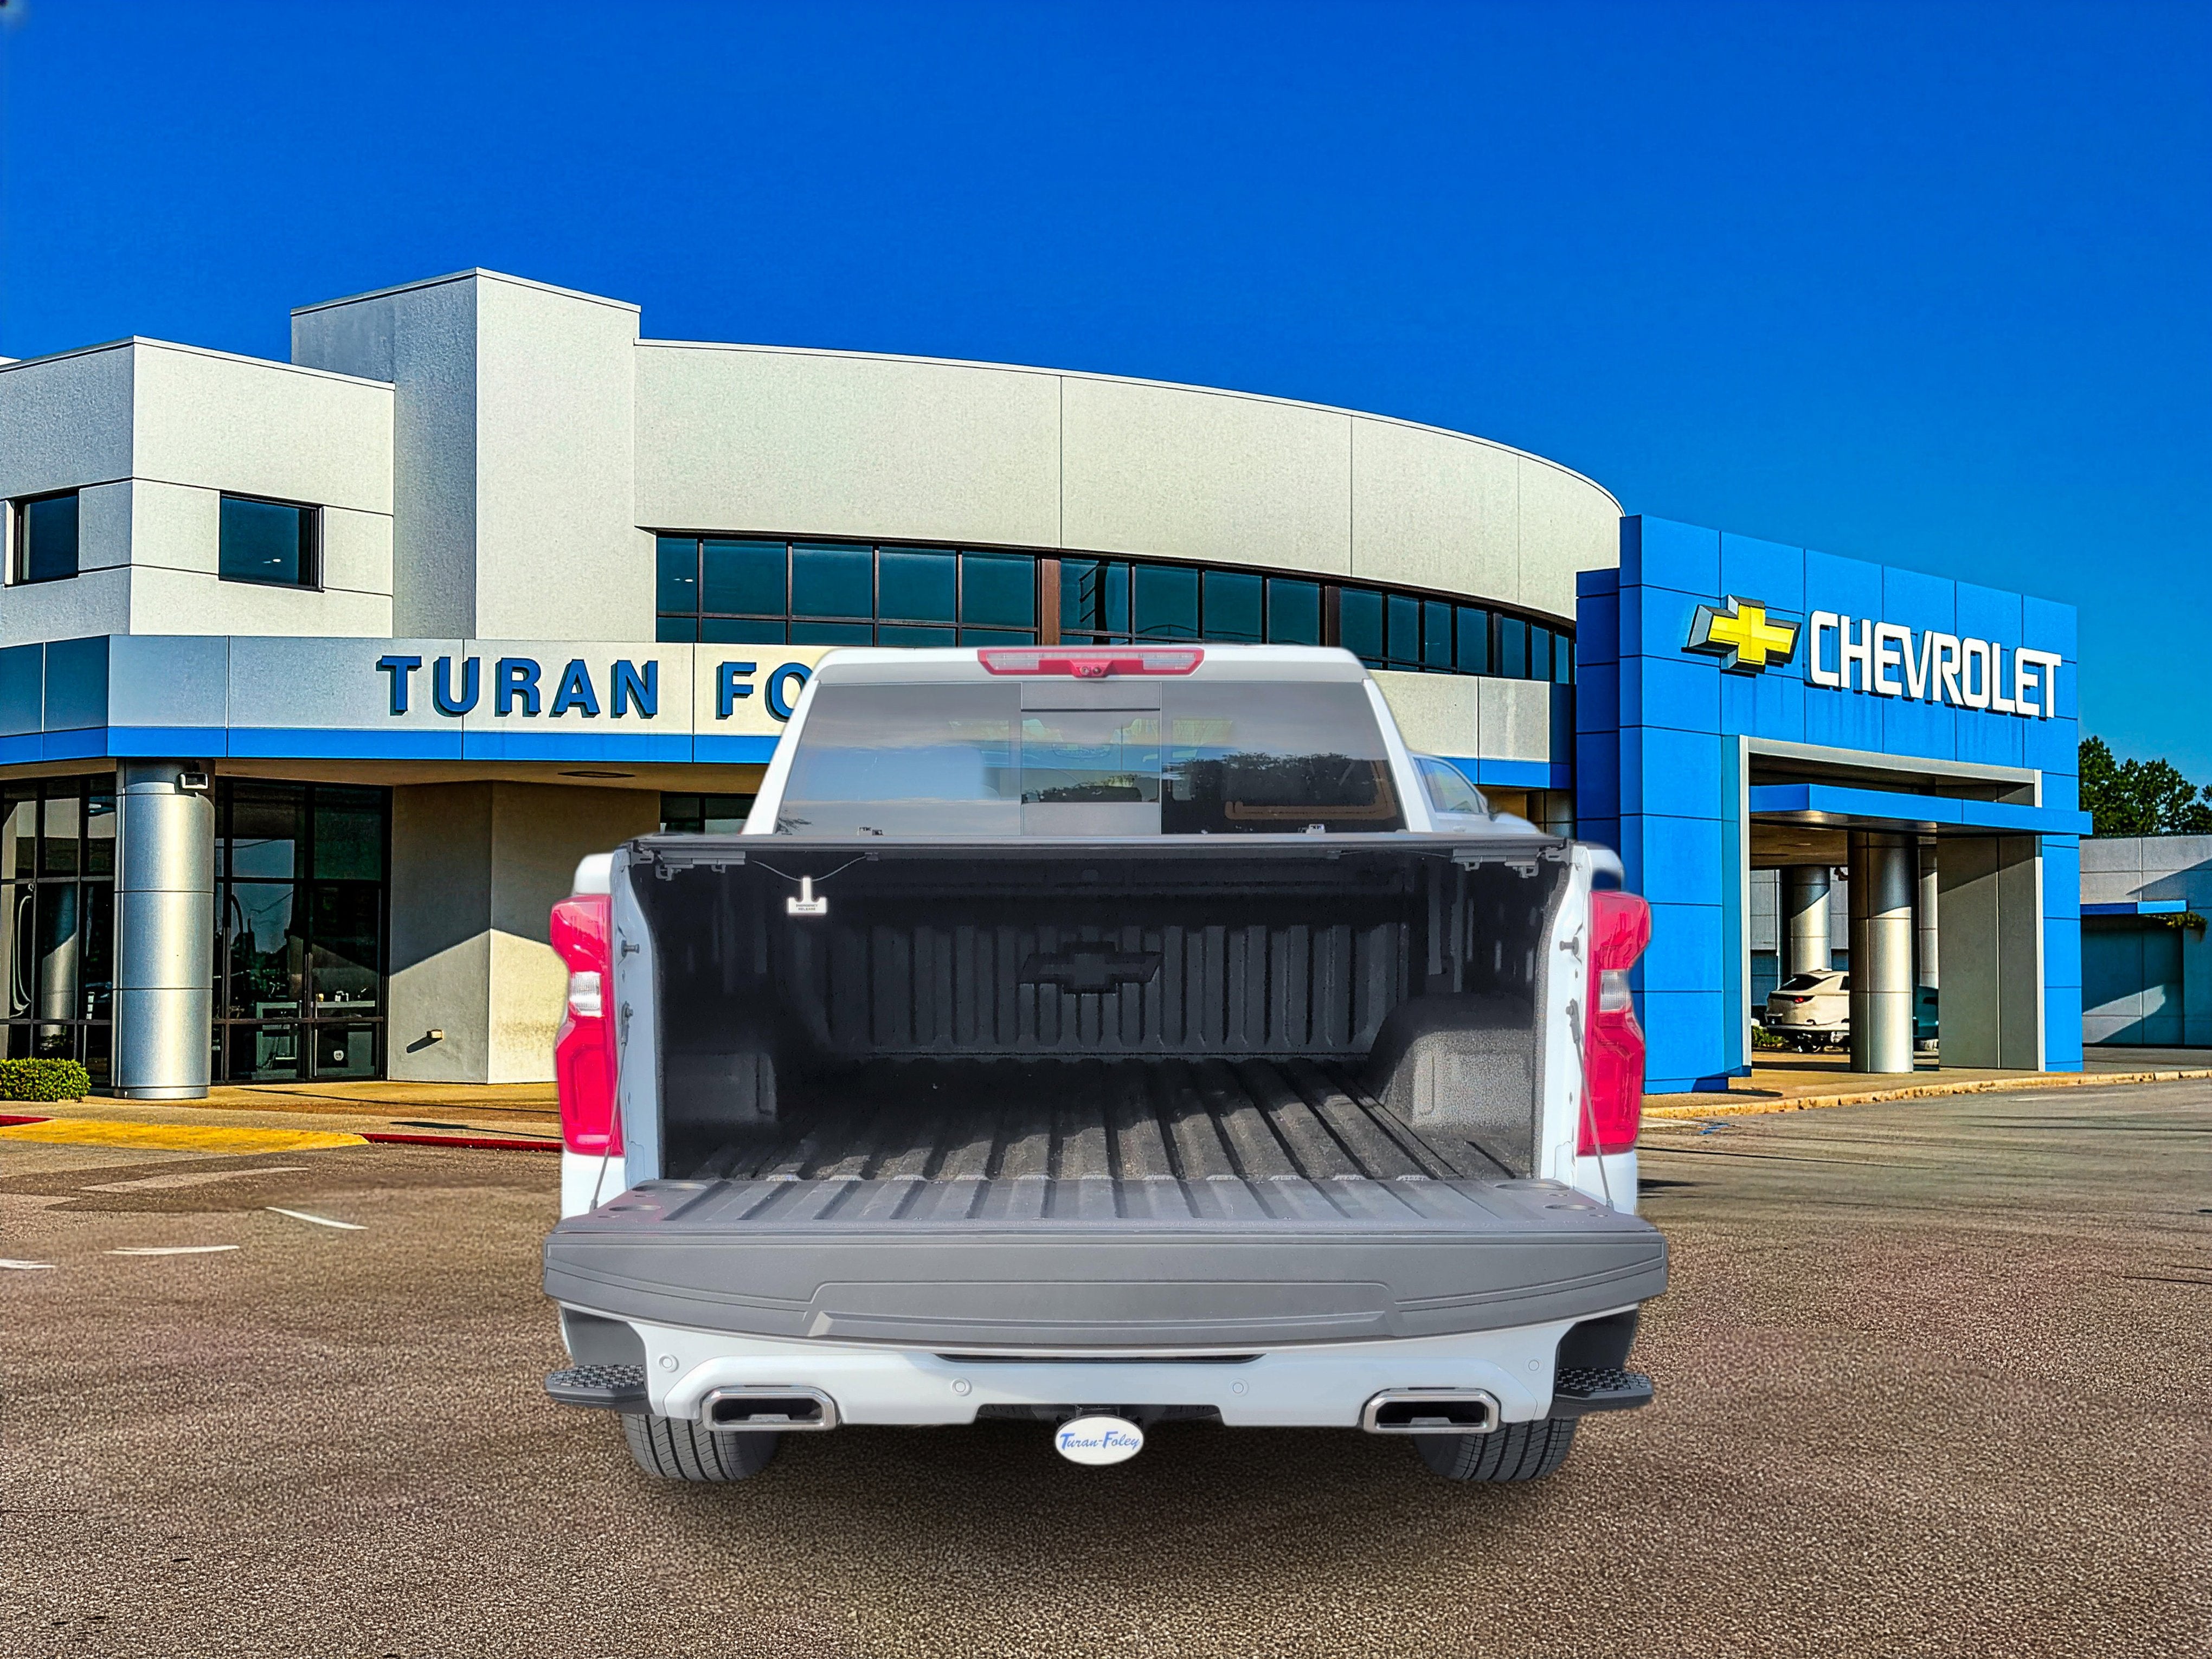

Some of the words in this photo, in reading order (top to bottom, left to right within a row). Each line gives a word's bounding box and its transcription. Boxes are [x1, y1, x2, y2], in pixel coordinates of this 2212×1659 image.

[376, 655, 658, 719] TURAN
[1810, 610, 2062, 718] CHEVROLET
[1060, 1431, 1140, 1451] Turan-Foley
